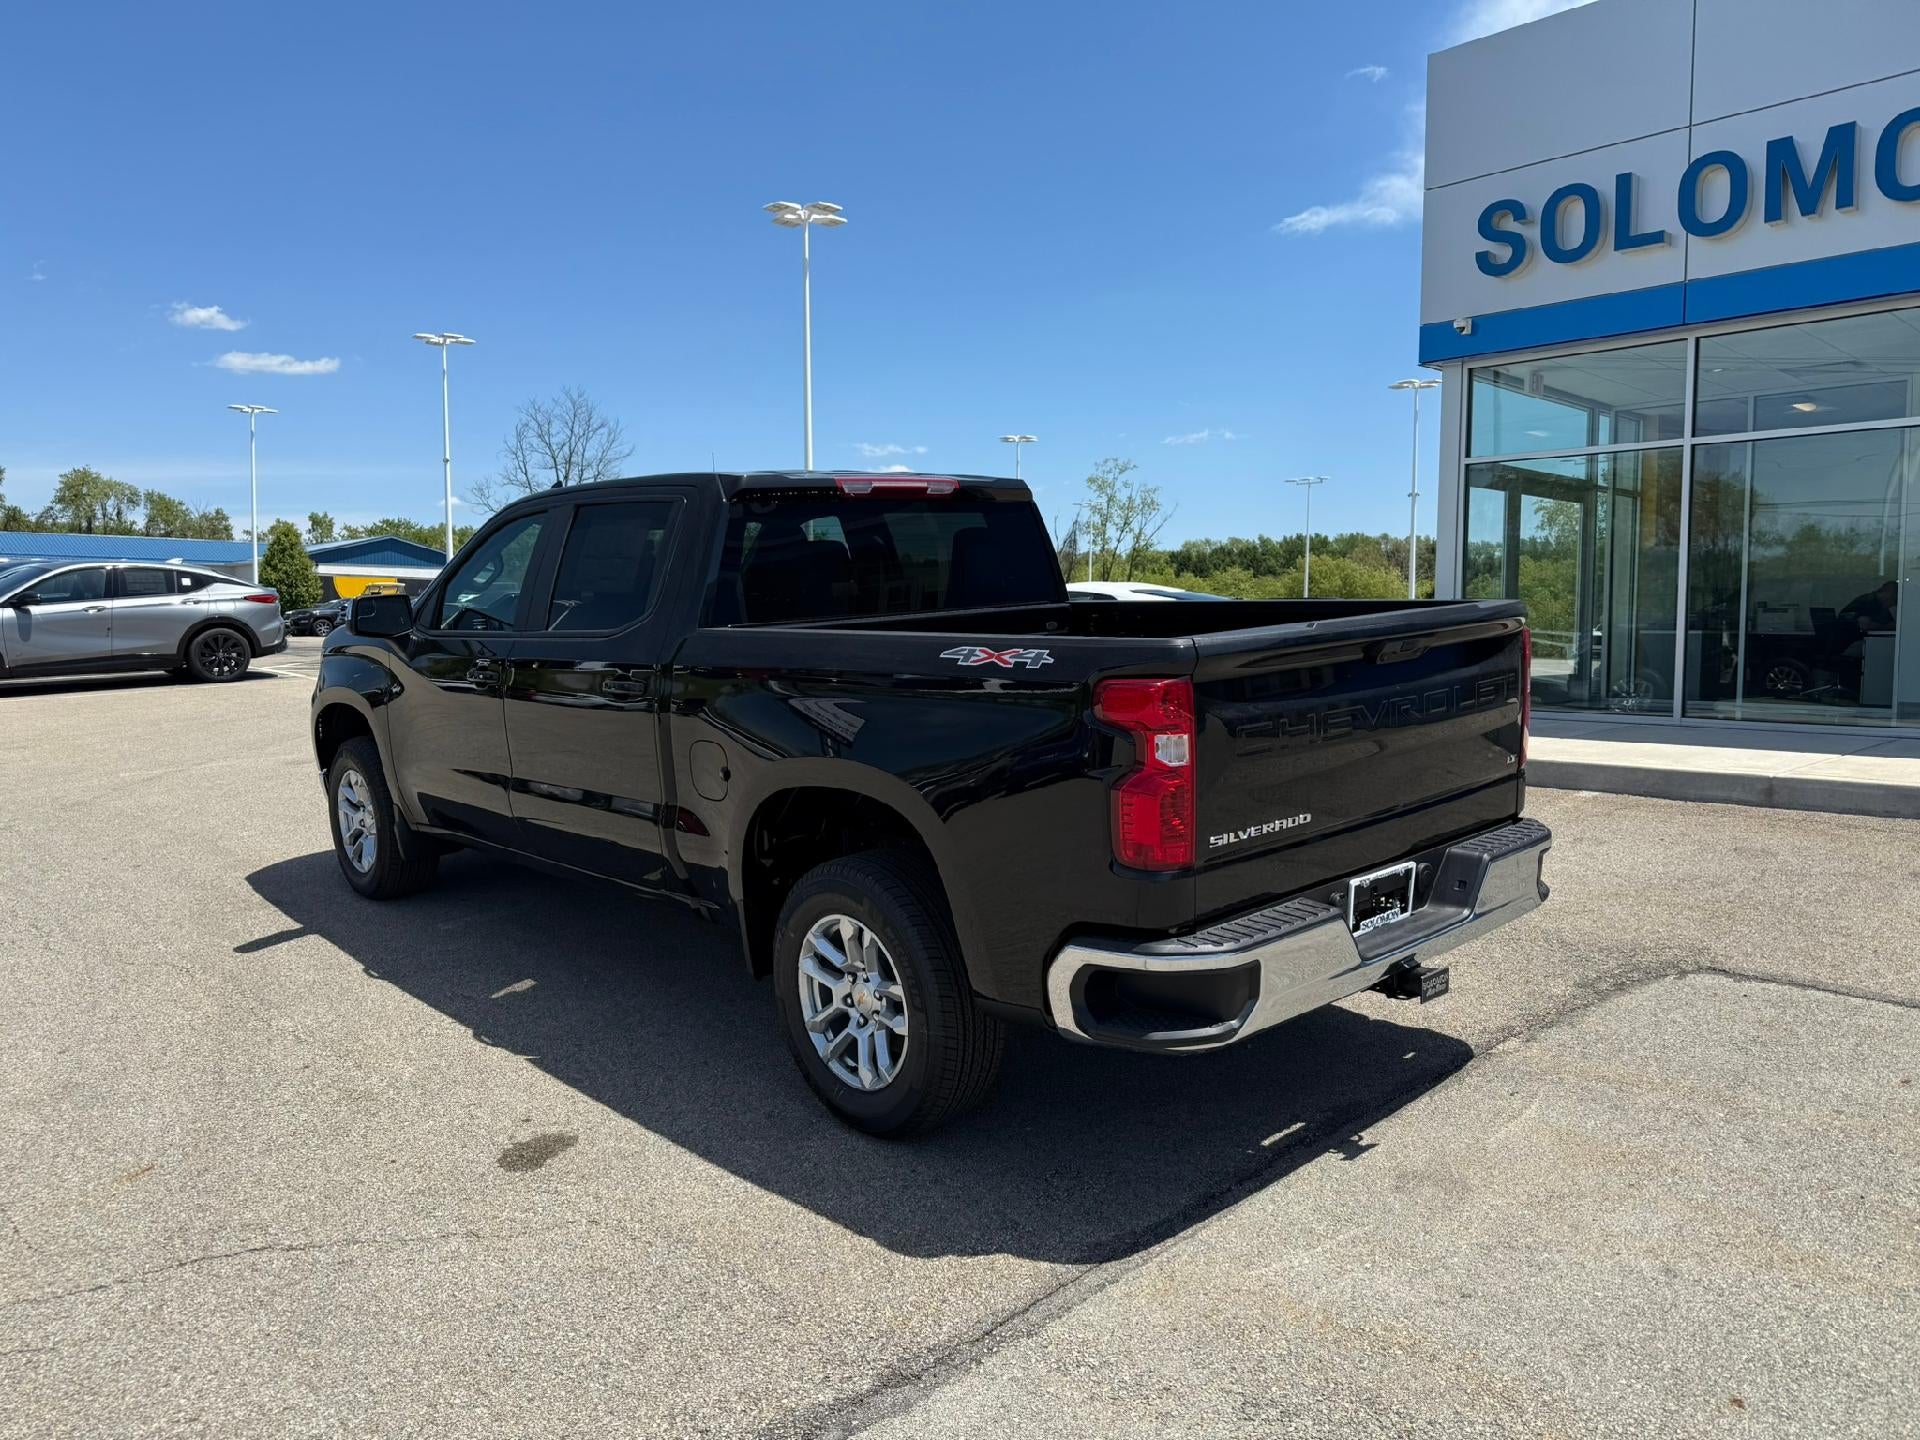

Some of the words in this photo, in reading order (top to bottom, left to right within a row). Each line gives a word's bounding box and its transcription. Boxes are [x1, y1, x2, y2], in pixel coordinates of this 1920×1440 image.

[1235, 672, 1517, 757] CHEVROLET
[1208, 813, 1312, 848] SILVERADO
[1361, 908, 1401, 931] SOLOMON
